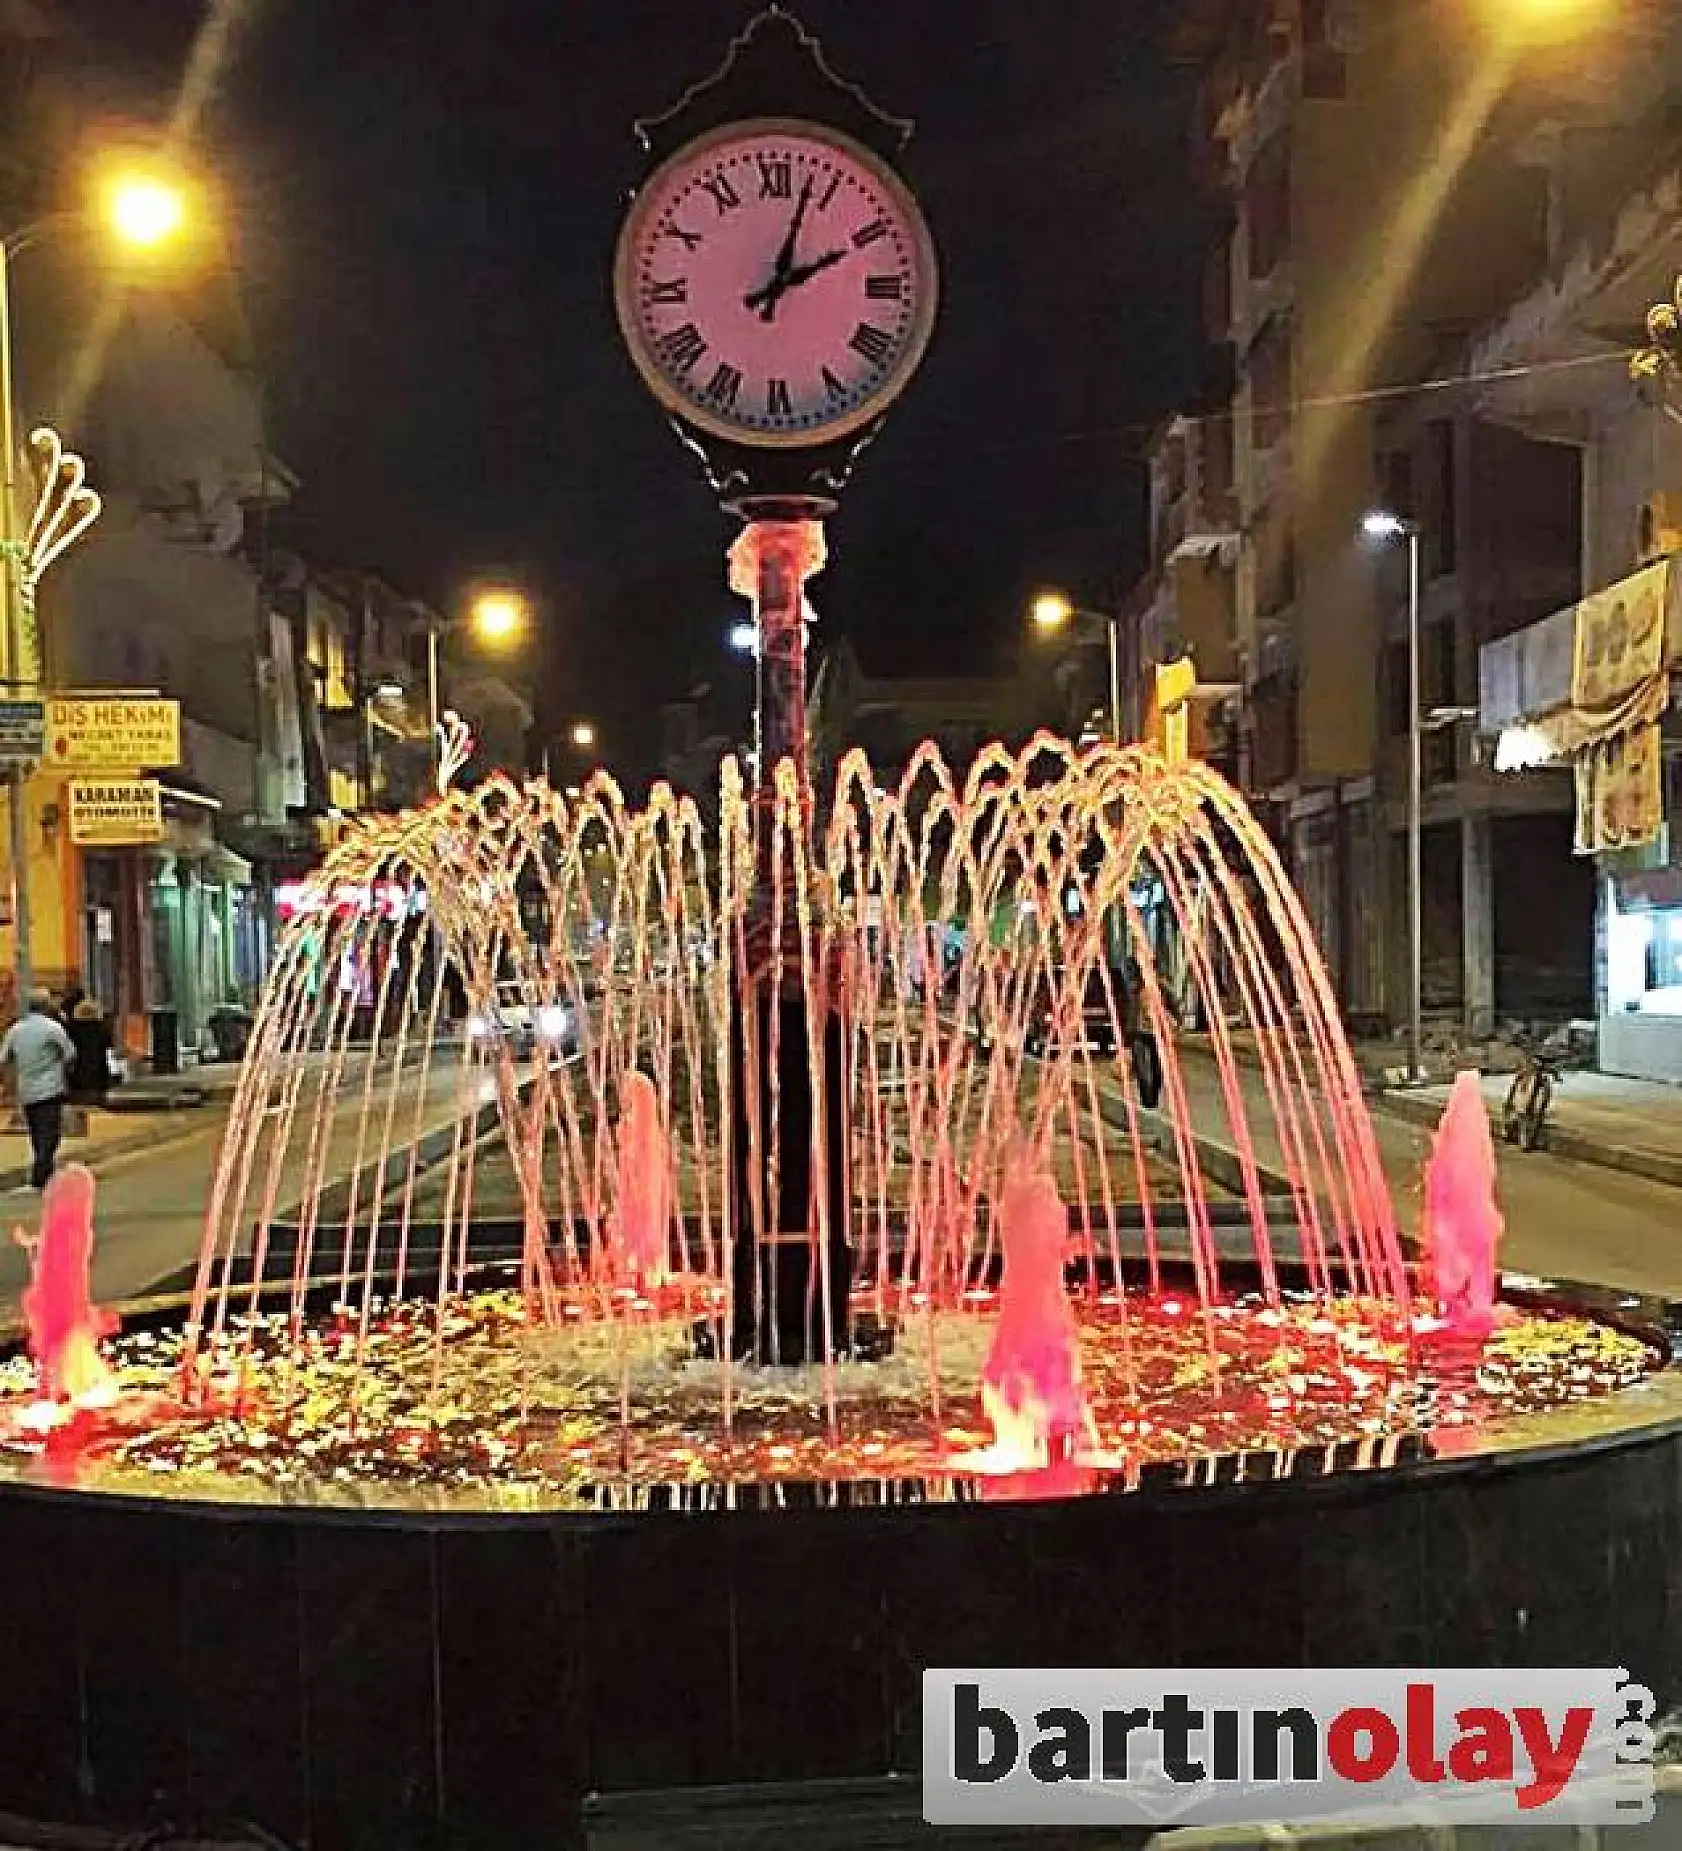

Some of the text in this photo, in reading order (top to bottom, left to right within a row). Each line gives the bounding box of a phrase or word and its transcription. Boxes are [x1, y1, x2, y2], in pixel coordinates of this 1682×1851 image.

[757, 160, 793, 200] XII
[850, 218, 890, 248] II
[864, 274, 901, 300] III
